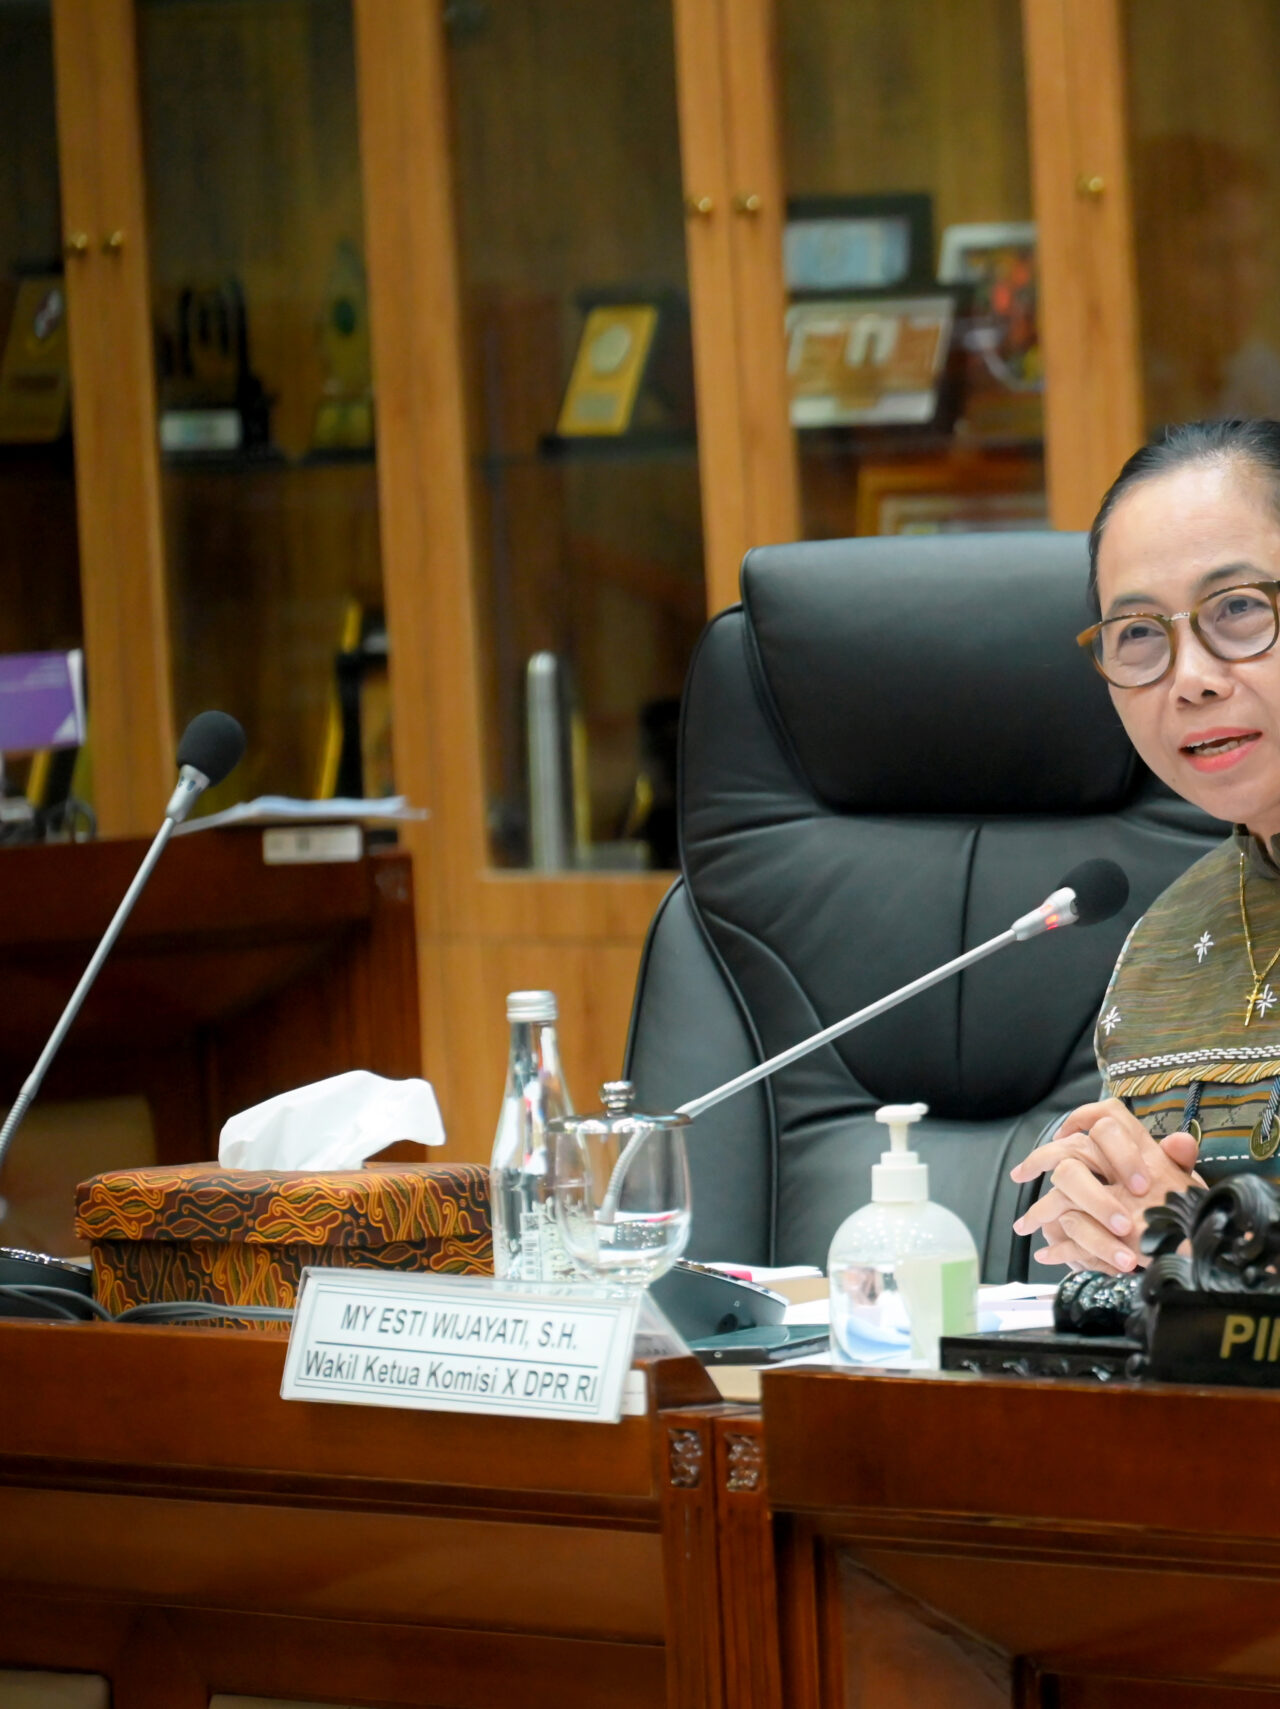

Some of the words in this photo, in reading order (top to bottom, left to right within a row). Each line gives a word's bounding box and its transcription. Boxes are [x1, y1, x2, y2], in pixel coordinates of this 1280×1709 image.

[340, 1303, 376, 1332] MY
[377, 1307, 428, 1337] ESTI
[431, 1311, 529, 1349] WIJAYATI,
[538, 1321, 577, 1350] S.H.
[305, 1349, 359, 1380] Wakil
[362, 1355, 420, 1386] Ketua
[426, 1361, 499, 1394] Komisi
[502, 1367, 519, 1395] X
[523, 1370, 569, 1400] DPR
[574, 1374, 598, 1403] RI
